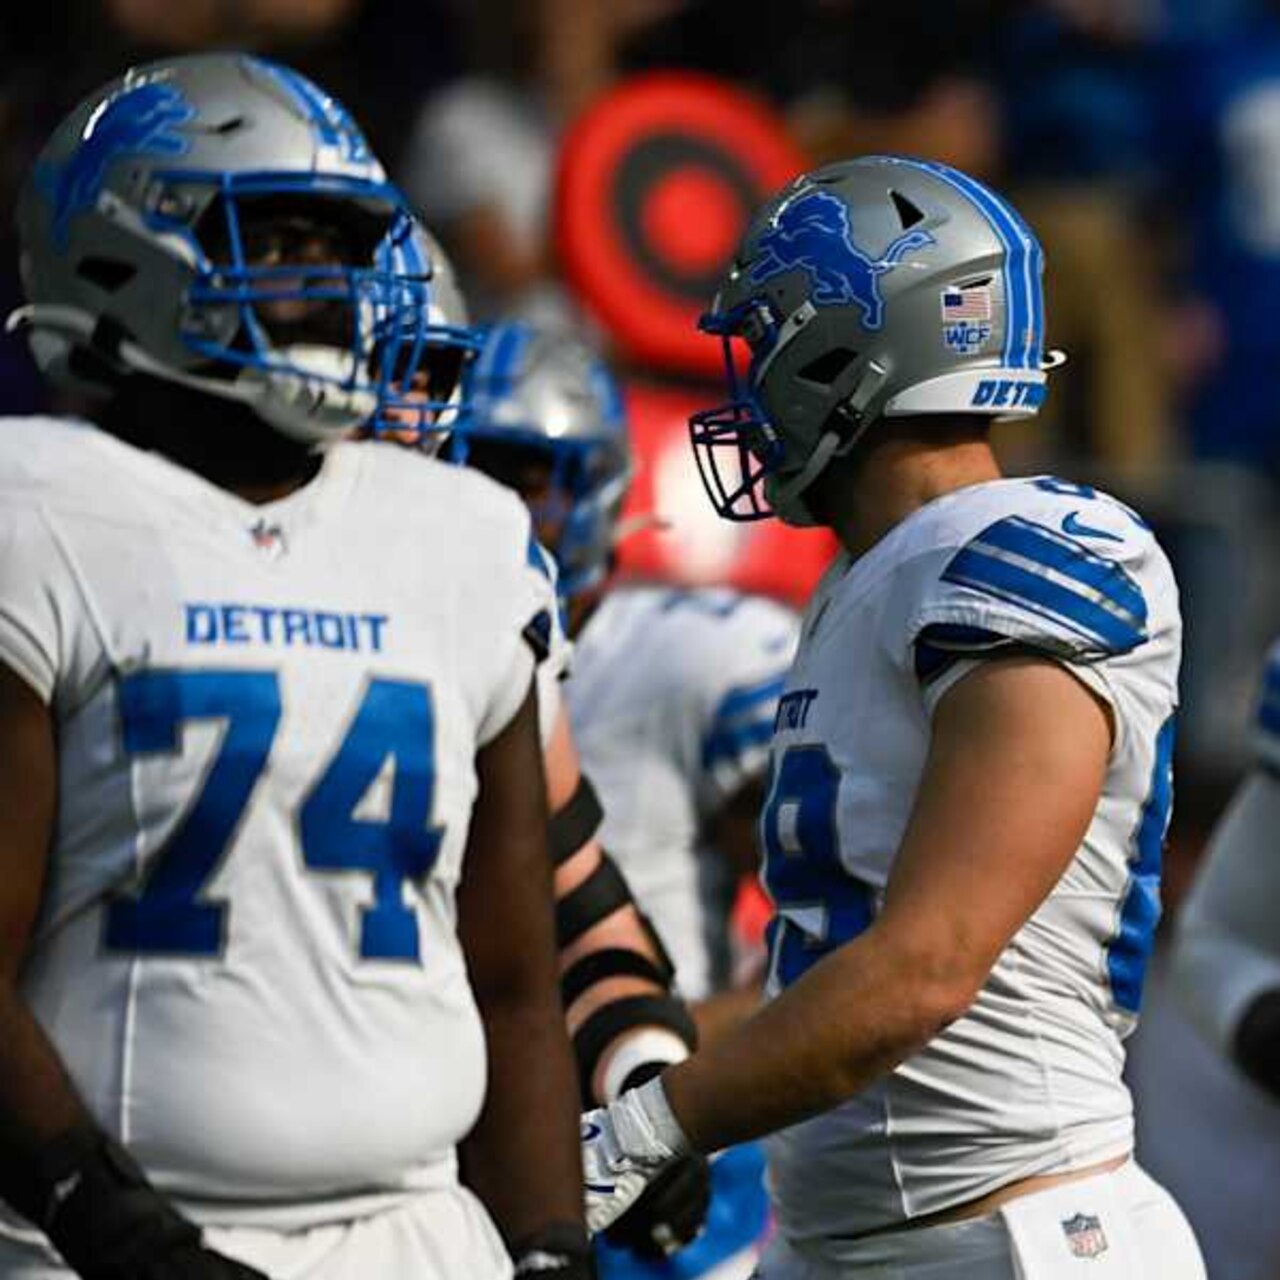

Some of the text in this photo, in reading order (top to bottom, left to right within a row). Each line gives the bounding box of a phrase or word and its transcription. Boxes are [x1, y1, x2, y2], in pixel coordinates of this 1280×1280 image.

[945, 327, 990, 345] WCF
[185, 603, 390, 653] DETROIT
[103, 667, 447, 963] 74
